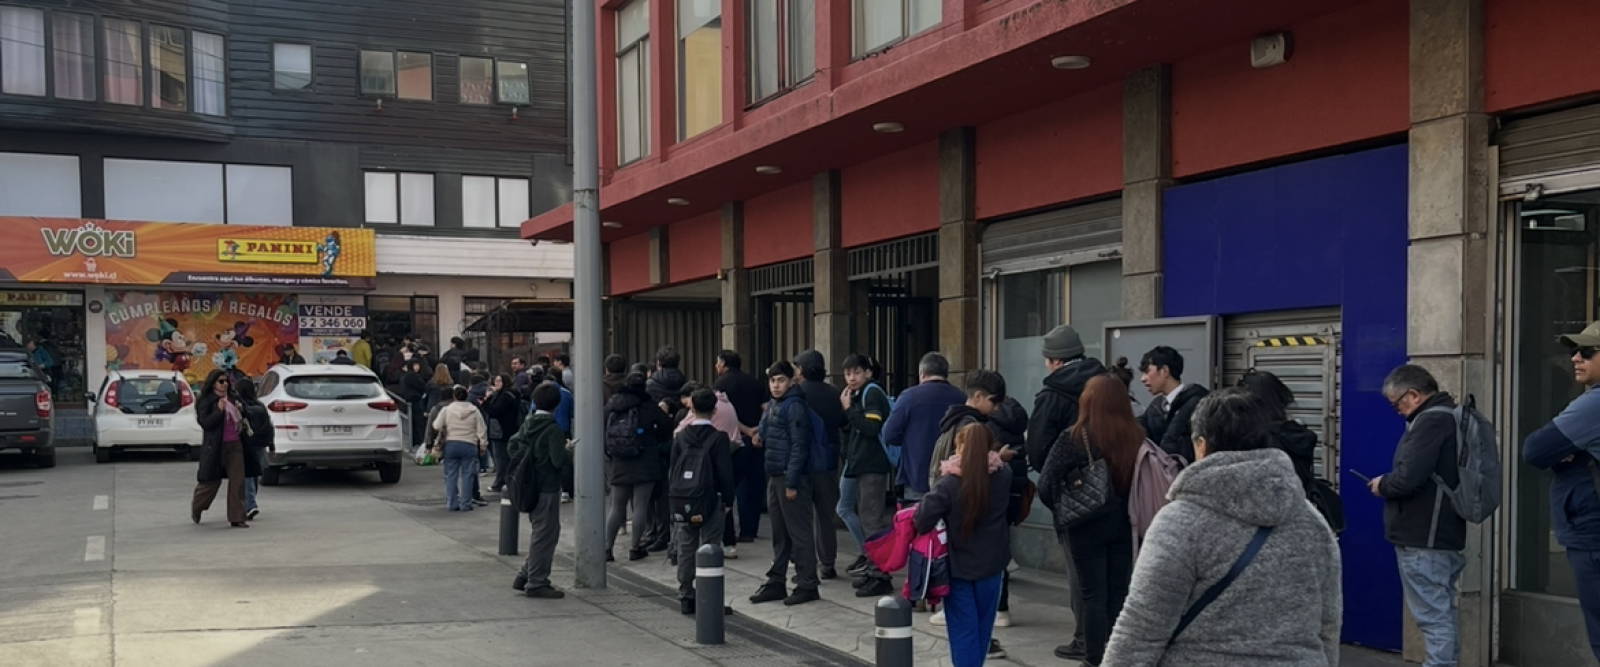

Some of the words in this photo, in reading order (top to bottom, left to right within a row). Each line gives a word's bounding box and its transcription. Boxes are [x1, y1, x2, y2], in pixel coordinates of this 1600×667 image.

[246, 242, 314, 254] PANINI
[63, 271, 117, 280] www.woki.cl
[220, 276, 233, 284] aquí
[108, 298, 212, 325] CUMPLEAÑOS
[214, 300, 224, 309] Y
[229, 302, 293, 326] REGALOS
[304, 306, 352, 316] VENDE
[320, 318, 340, 328] 346
[342, 318, 364, 328] 060
